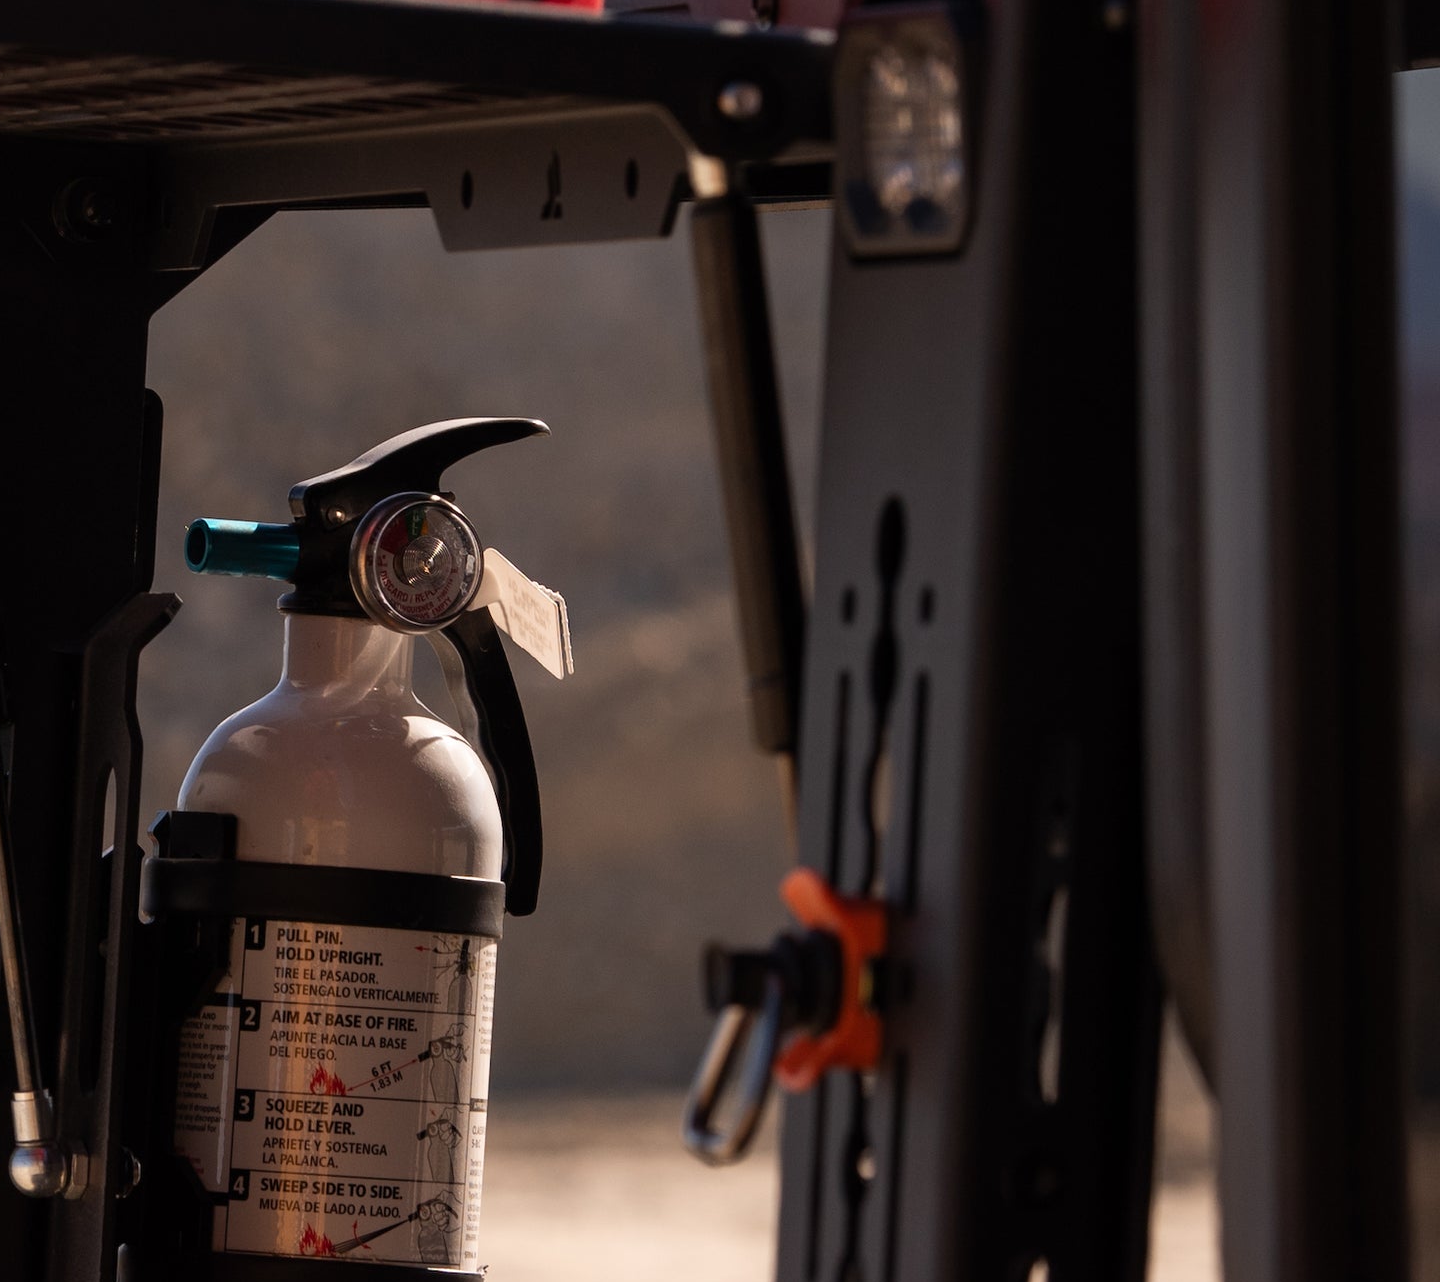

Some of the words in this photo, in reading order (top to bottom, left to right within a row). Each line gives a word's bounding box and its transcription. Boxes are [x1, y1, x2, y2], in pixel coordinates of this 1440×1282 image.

[379, 571, 408, 602] DISCARD
[249, 924, 260, 945] 1
[277, 928, 310, 943] PULL
[315, 930, 343, 946] PIN.
[275, 947, 315, 962] HOLD
[320, 949, 384, 967] UPRIGHT.
[274, 967, 299, 980] TIRE
[303, 968, 316, 981] EL
[320, 970, 379, 985] PASADOR.
[273, 982, 351, 1000] SOSTENGALO
[354, 987, 442, 1005] VERTICALMENTE.
[244, 1006, 256, 1026] 2
[271, 1010, 300, 1024] AIM
[303, 1011, 321, 1025] AT
[325, 1013, 361, 1028] BASE
[366, 1015, 384, 1030] OF
[387, 1017, 418, 1032] FIRE.
[270, 1030, 317, 1045] APUNTE
[321, 1033, 358, 1048] HACIA
[362, 1036, 376, 1049] LA
[380, 1037, 407, 1050] BASE
[269, 1045, 291, 1059] DEL
[295, 1047, 337, 1062] FUEGO.
[371, 1066, 381, 1078] 6
[381, 1061, 393, 1075] FT
[370, 1075, 392, 1093] 1.83
[393, 1072, 404, 1086] M
[238, 1094, 250, 1115] 3
[265, 1098, 328, 1116] SQUEEZE
[332, 1102, 364, 1118] AND
[265, 1117, 303, 1132] HOLD
[307, 1120, 356, 1136] LEVER.
[263, 1137, 310, 1152] APRIETE
[313, 1140, 323, 1152] Y
[325, 1141, 388, 1157] SOSTENGA
[262, 1151, 276, 1165] LA
[280, 1153, 339, 1169] PALANCA.
[232, 1175, 245, 1195] 4
[260, 1177, 307, 1194] SWEEP
[312, 1181, 344, 1196] SIDE
[348, 1183, 367, 1198] TO
[370, 1185, 403, 1200] SIDE.
[259, 1198, 300, 1213] MUEVA
[304, 1200, 320, 1214] DE
[324, 1201, 356, 1216] LADO
[358, 1203, 367, 1217] A
[370, 1204, 401, 1219] LADO.
